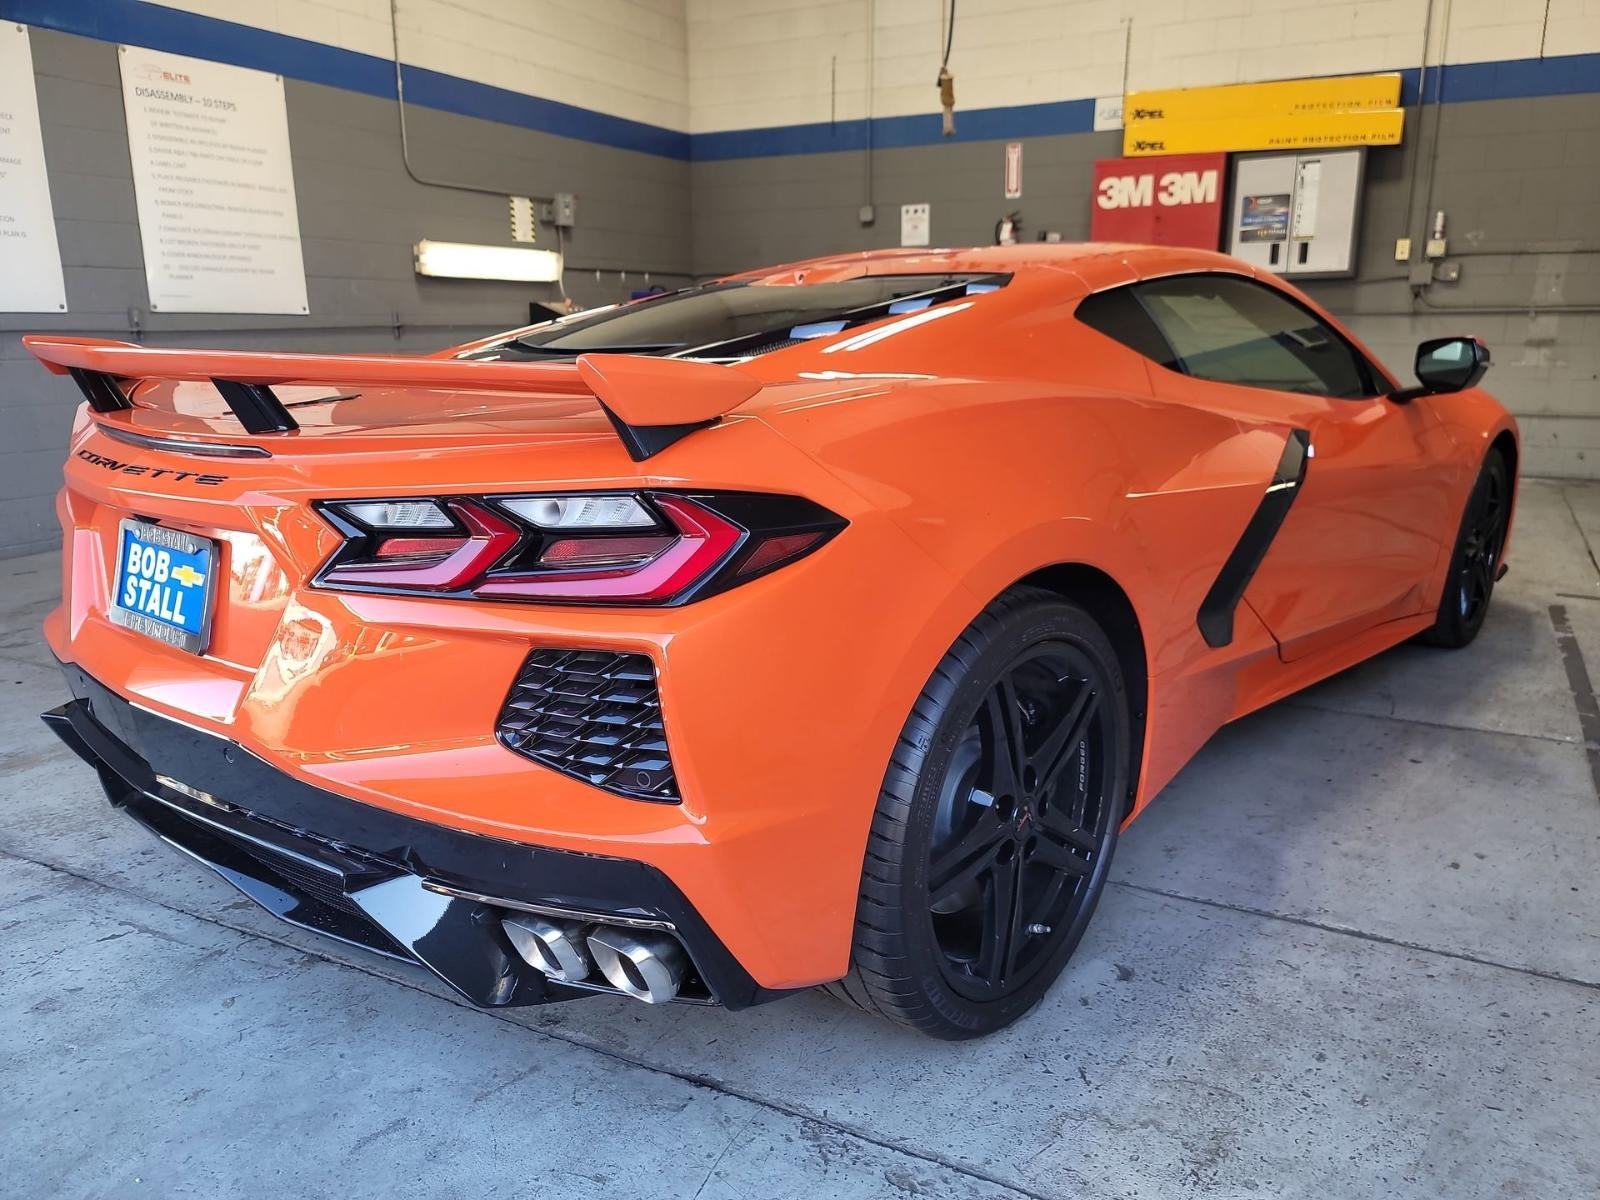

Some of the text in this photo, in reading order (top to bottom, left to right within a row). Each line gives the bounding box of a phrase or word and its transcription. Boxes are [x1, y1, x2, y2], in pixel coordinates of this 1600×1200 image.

[135, 86, 193, 104] DISASSEMBLY
[214, 99, 237, 112] STEPS
[1294, 101, 1361, 111] PROTECTION
[1302, 134, 1367, 144] PROTECTION
[1371, 132, 1396, 141] FILM
[1097, 169, 1219, 210] 3M 3M
[77, 449, 229, 486] CORVETTE
[128, 543, 171, 583] BOB
[124, 576, 185, 624] STALL
